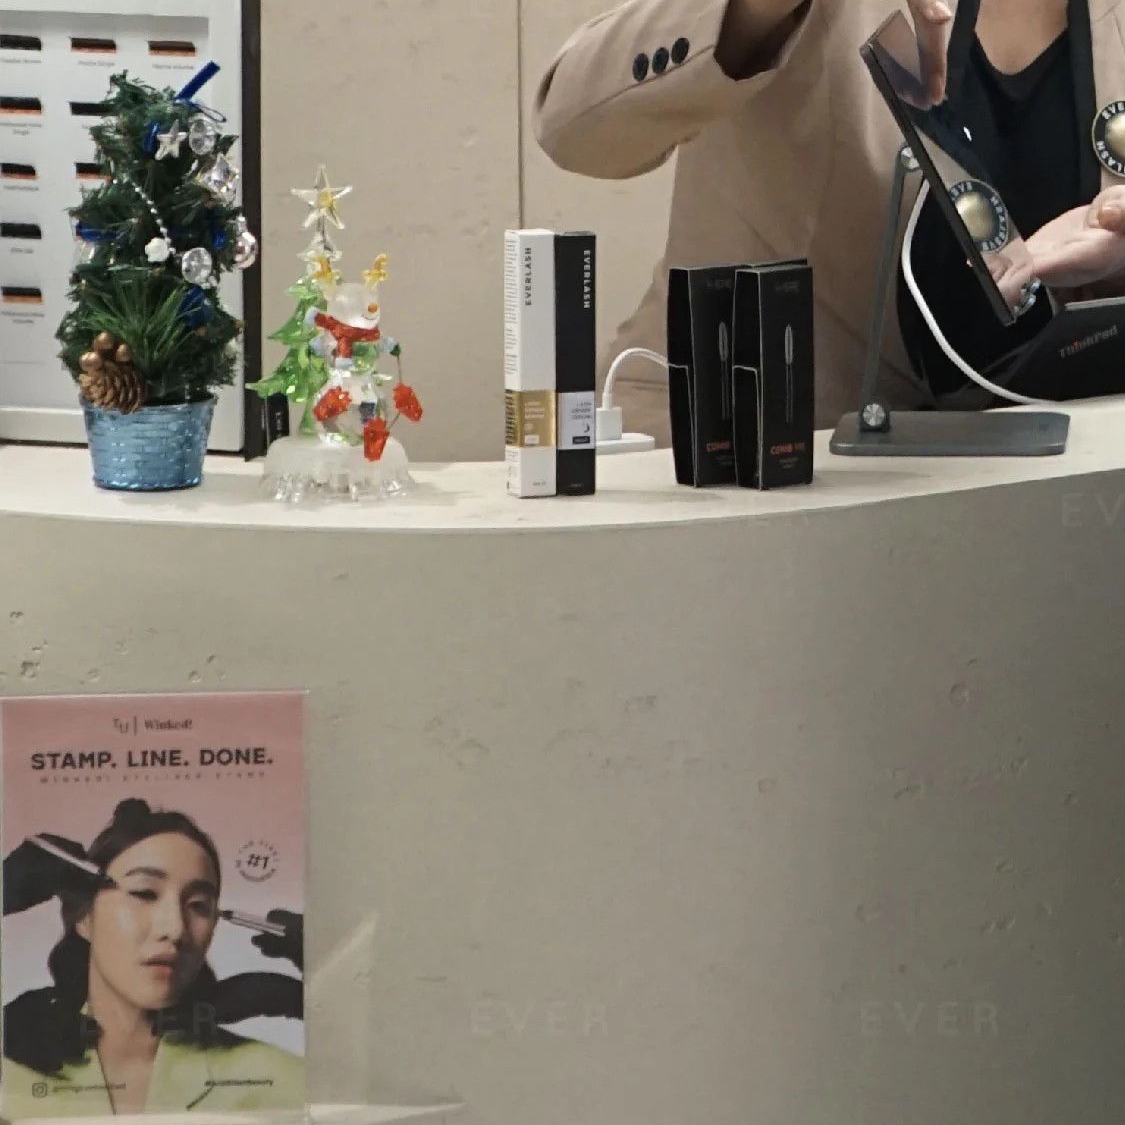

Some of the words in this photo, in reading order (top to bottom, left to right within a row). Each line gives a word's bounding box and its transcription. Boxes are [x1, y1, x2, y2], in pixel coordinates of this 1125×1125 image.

[524, 247, 532, 306] EVERLASH
[583, 249, 591, 309] EVERLASH
[1058, 324, 1118, 359] ThinkPad
[144, 717, 193, 731] Winked!
[31, 750, 117, 771] STAMP.
[127, 748, 190, 768] LINE.
[200, 746, 274, 766] DONE.
